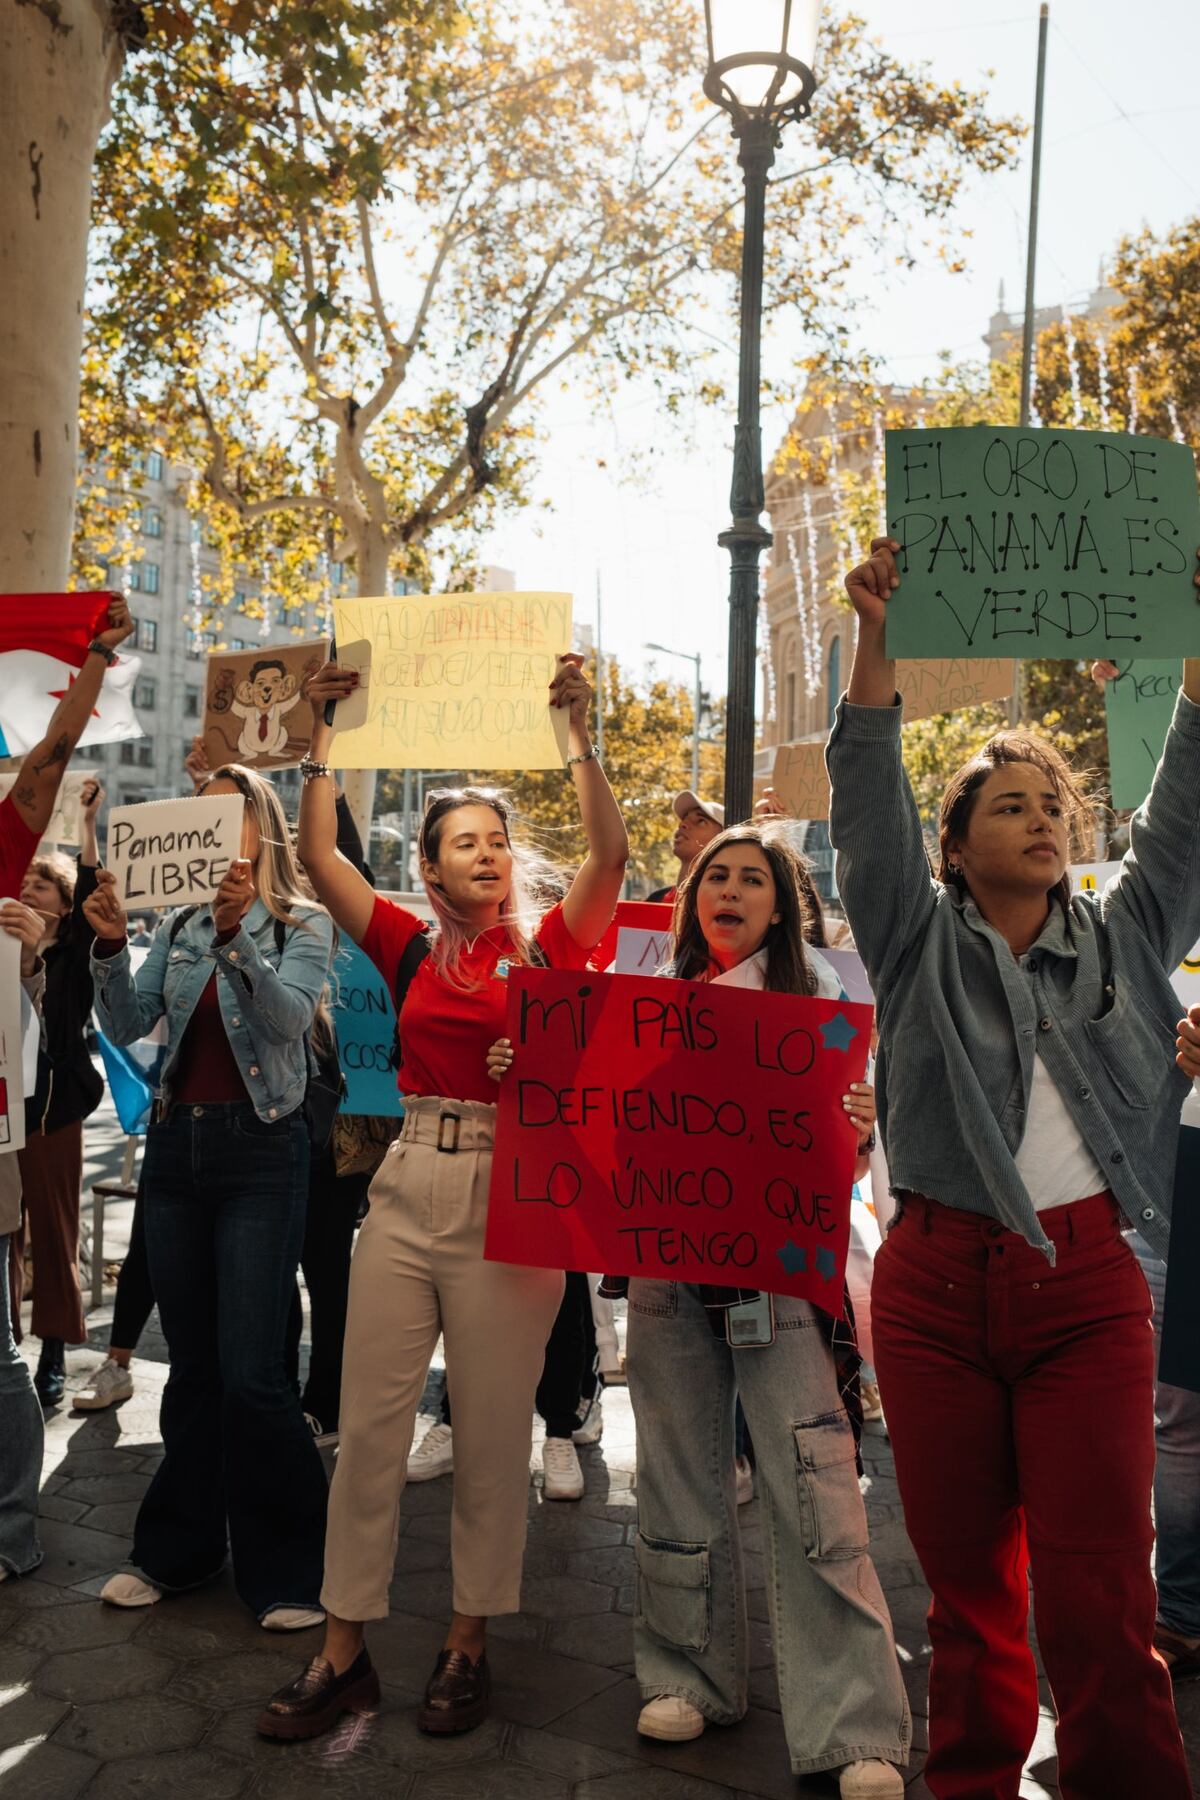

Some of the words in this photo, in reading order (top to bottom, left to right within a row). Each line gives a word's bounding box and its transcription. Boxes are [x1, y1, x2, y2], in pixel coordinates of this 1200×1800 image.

[902, 441, 967, 503] EL
[983, 438, 1078, 500] ORO
[1094, 443, 1159, 503] DE
[891, 499, 1108, 574] PANAMÁ
[1123, 517, 1187, 577] ES
[935, 587, 1142, 646] VERDE
[926, 681, 986, 716] VERDE
[111, 817, 222, 861] Panamá
[124, 856, 230, 899] LIBRE
[632, 992, 719, 1052] PAÍS
[753, 1016, 817, 1076] LO
[516, 1079, 755, 1144] DEFIENDO,
[767, 1108, 815, 1153] ES
[513, 1156, 583, 1210] LO
[611, 1155, 734, 1212] ÚNICO
[764, 1176, 838, 1234] QUE
[617, 1225, 760, 1270] TENGO
